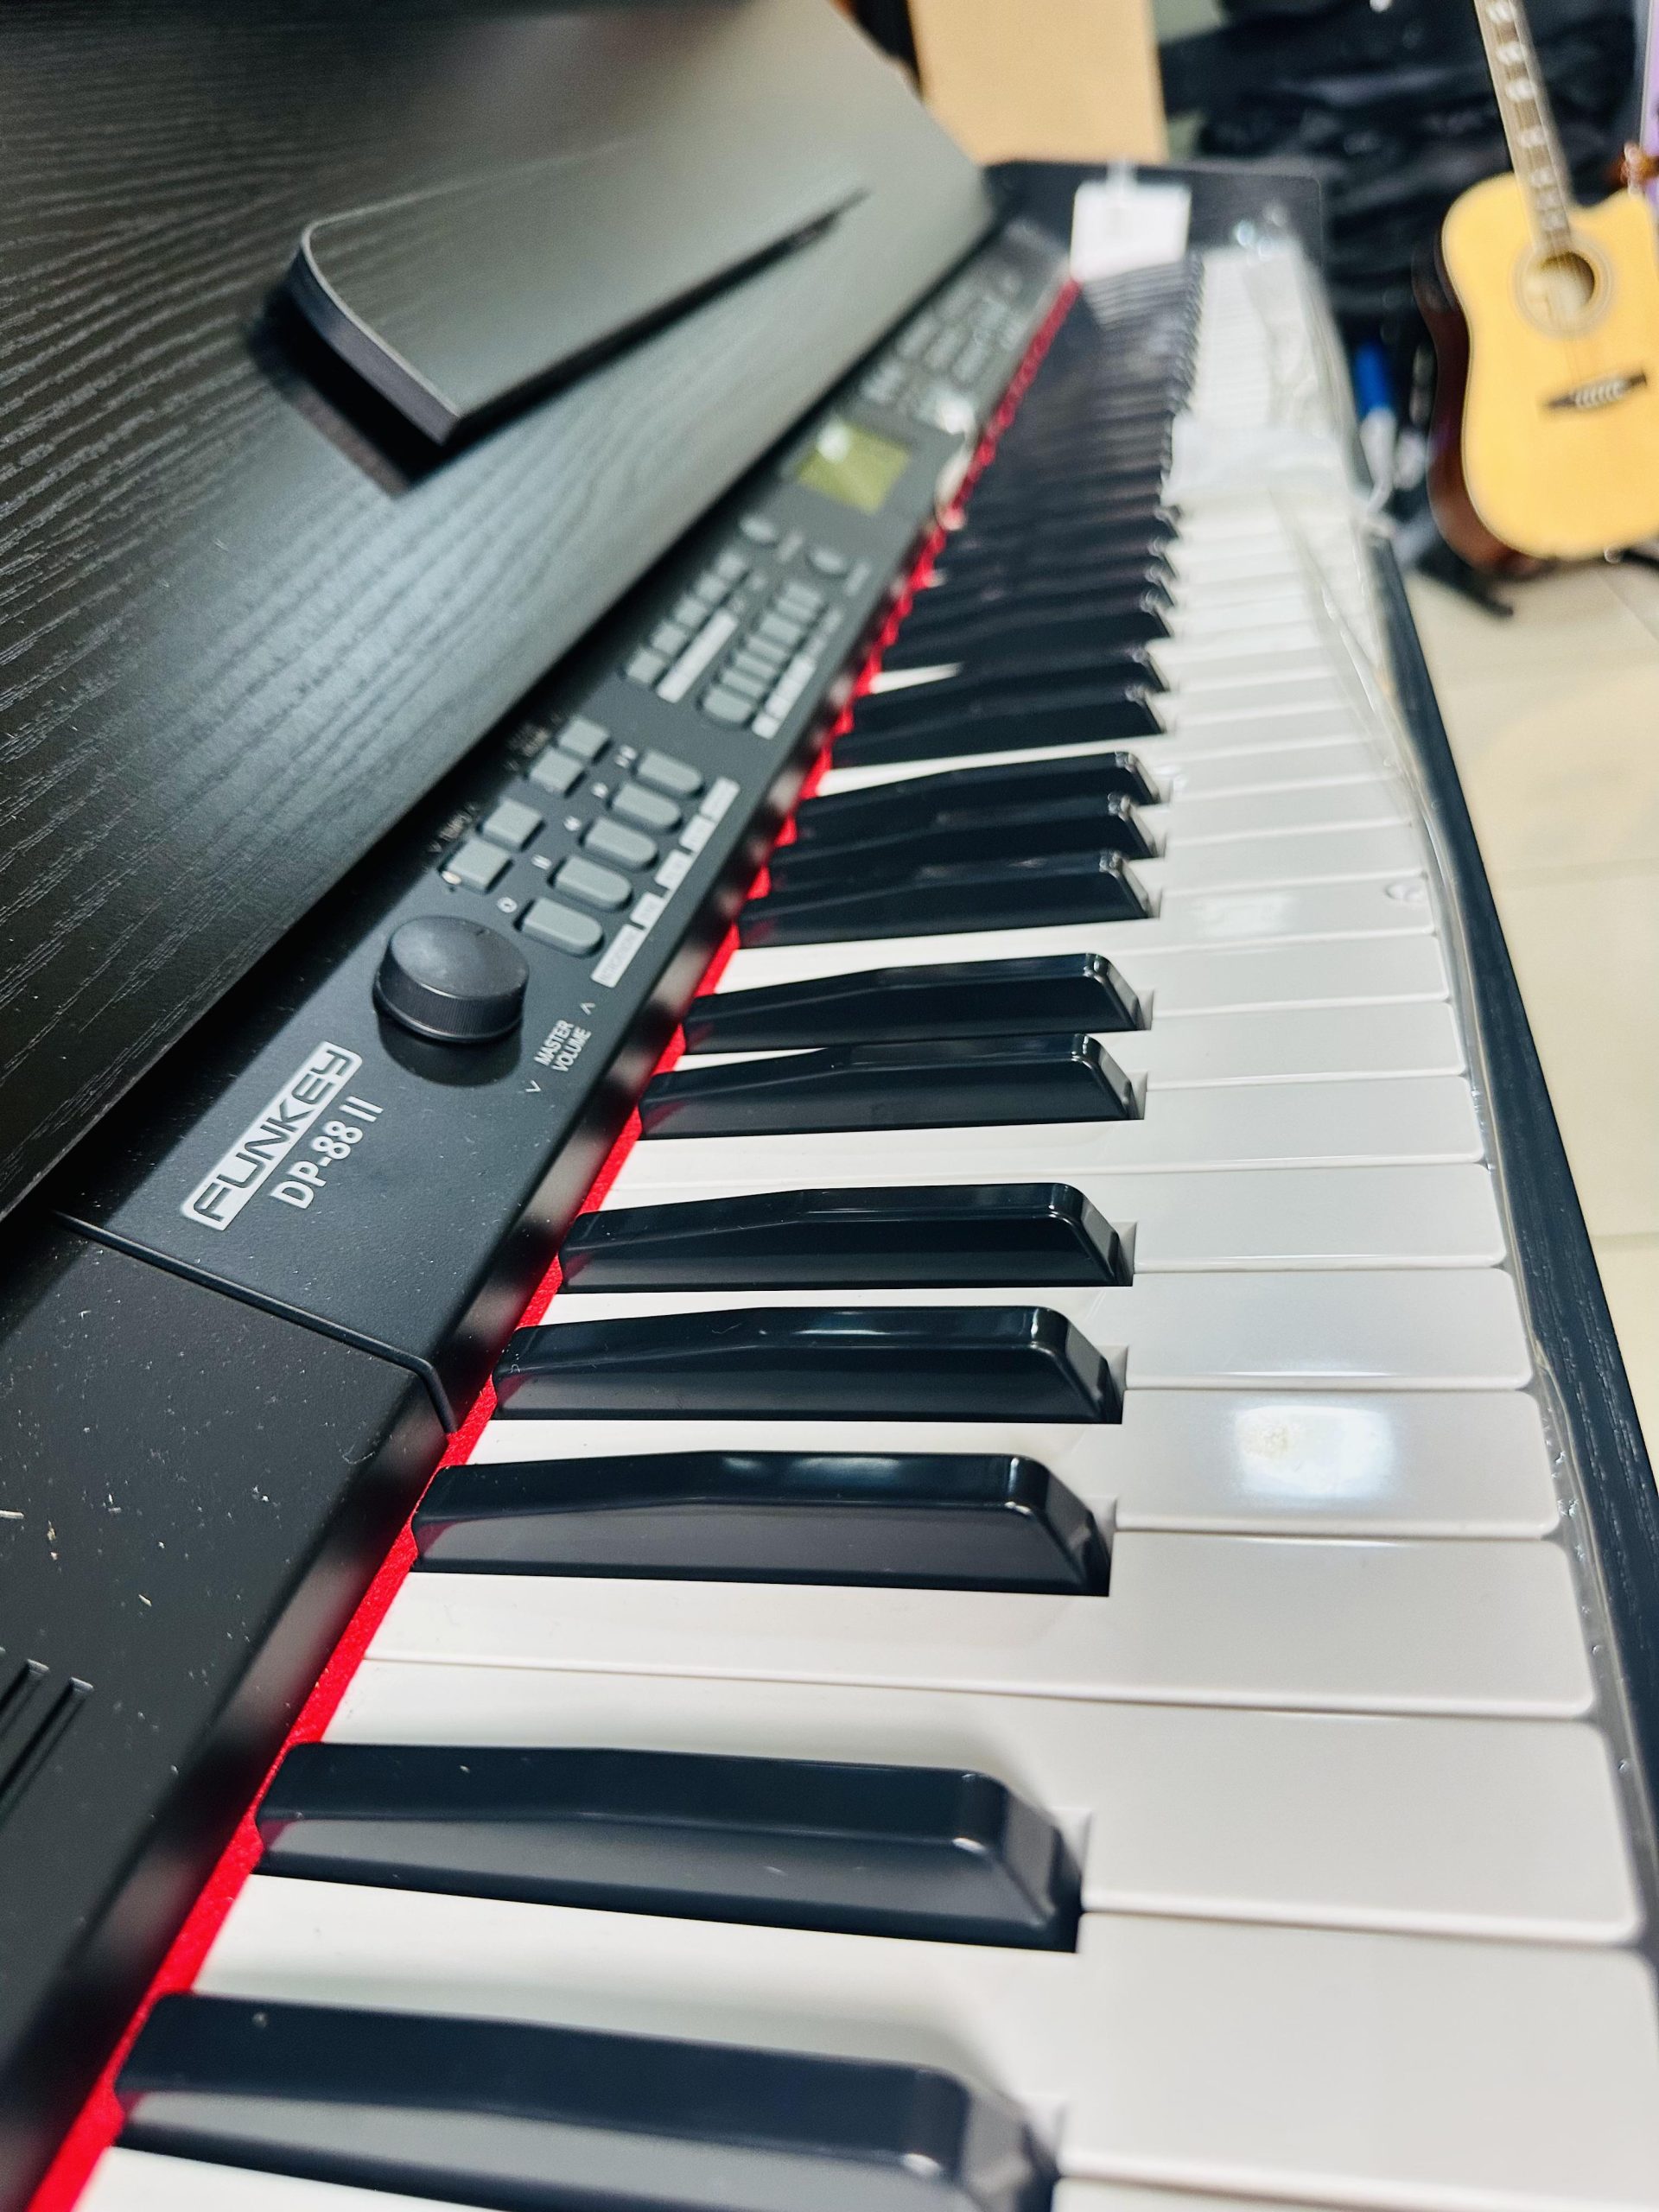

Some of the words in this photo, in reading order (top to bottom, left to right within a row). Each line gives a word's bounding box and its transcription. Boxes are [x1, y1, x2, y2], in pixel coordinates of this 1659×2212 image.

[533, 1020, 575, 1066] MASTER
[550, 1026, 592, 1071] VOLUME
[193, 1048, 355, 1223] FUNKEY
[270, 1120, 364, 1210] DP-88
